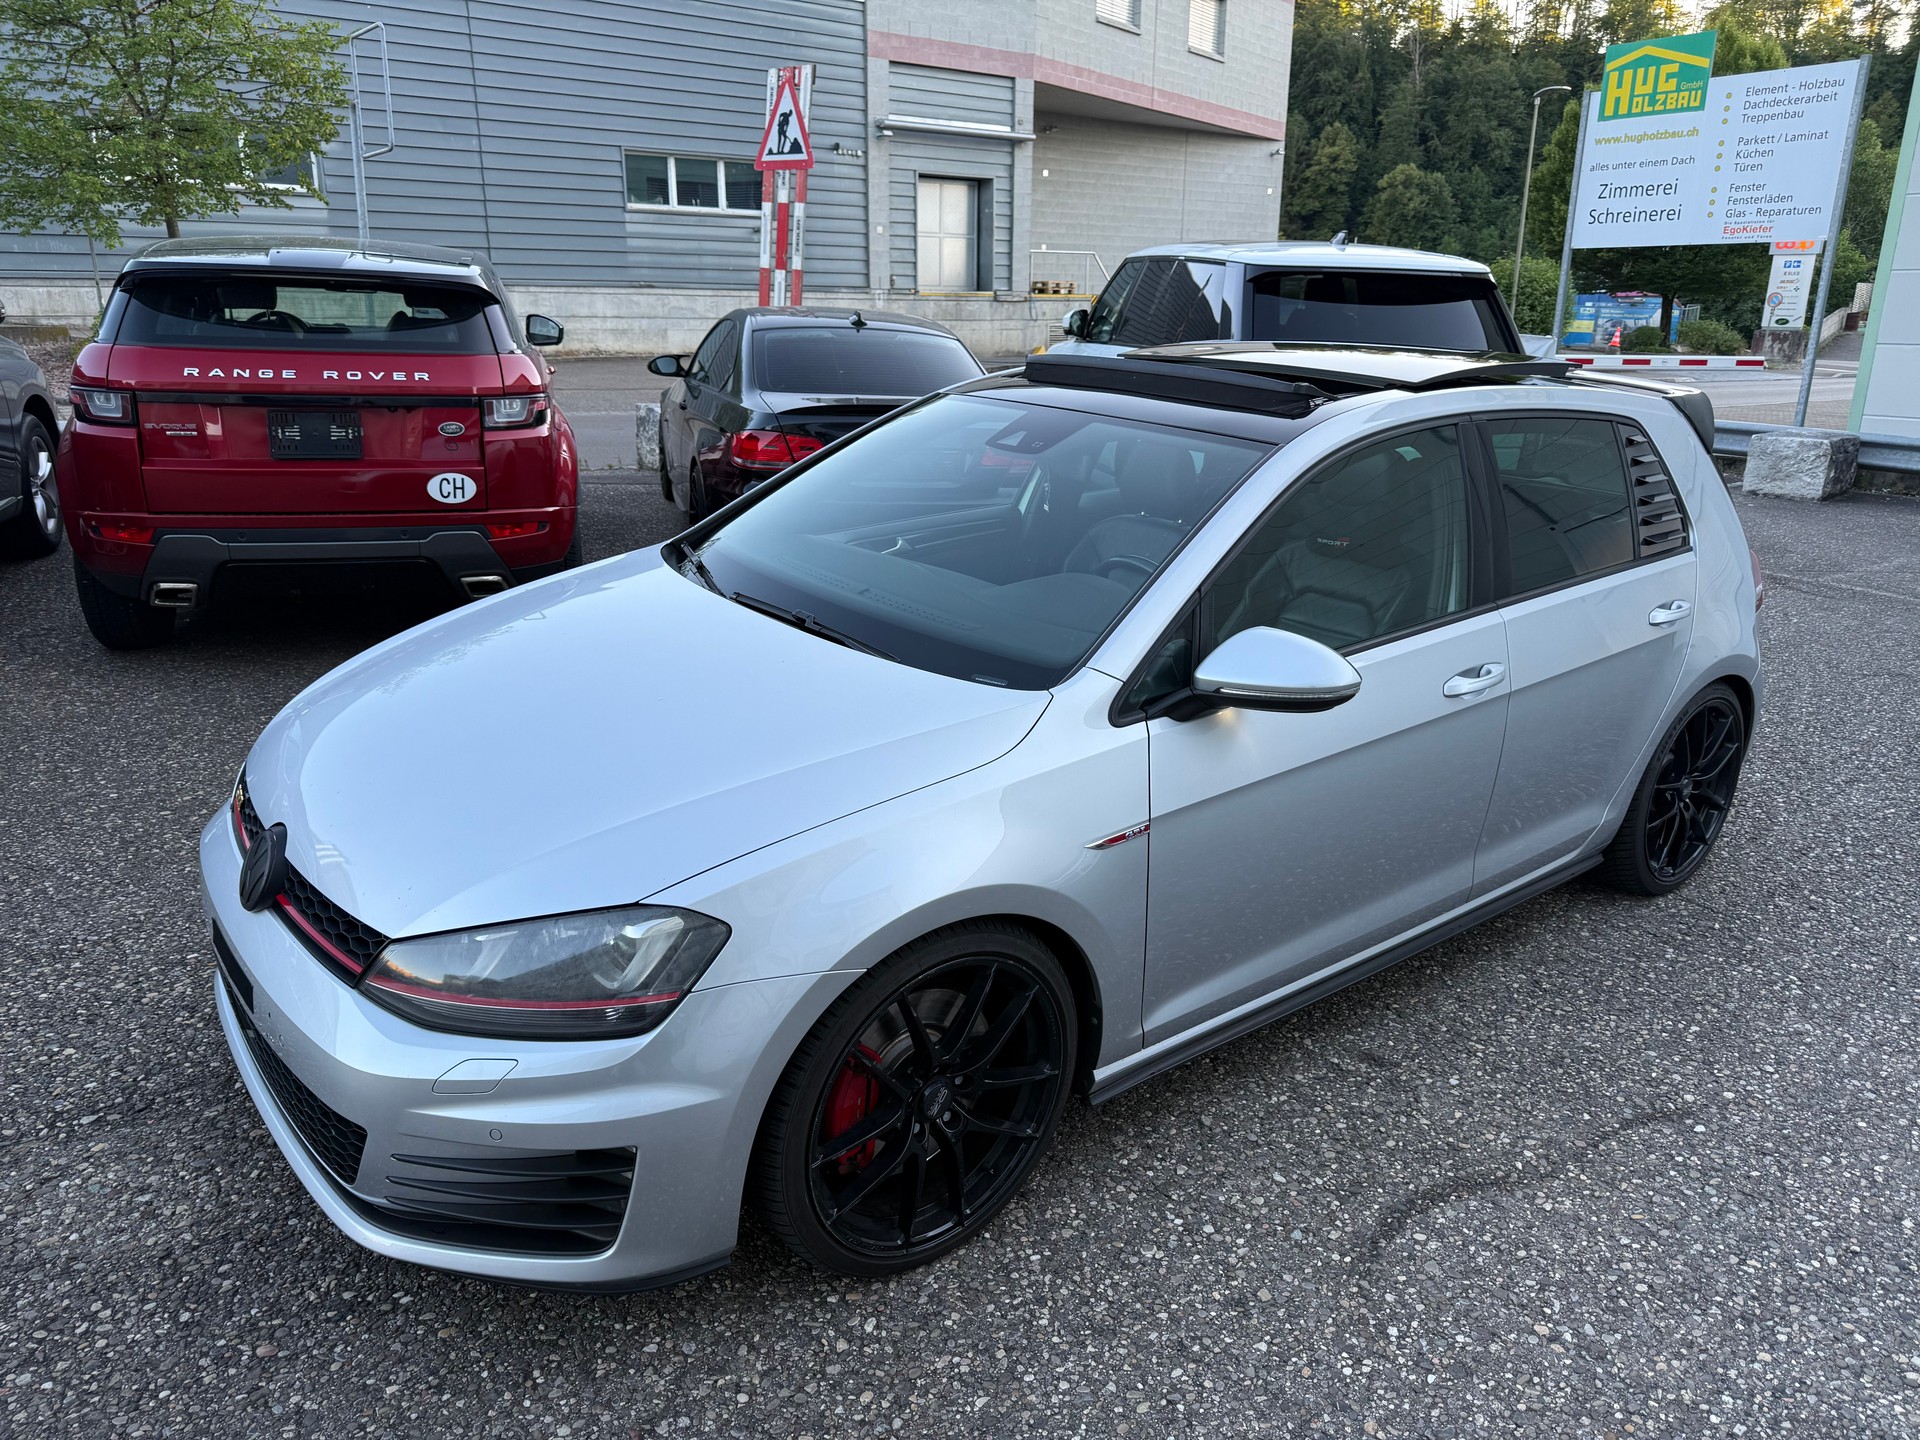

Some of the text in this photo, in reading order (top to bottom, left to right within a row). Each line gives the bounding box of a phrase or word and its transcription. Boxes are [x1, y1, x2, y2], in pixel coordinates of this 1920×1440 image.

[1604, 63, 1680, 116] HUG
[1680, 80, 1704, 90] GmbH
[1745, 83, 1789, 97] Element
[1798, 78, 1846, 91] Holzbau
[1743, 91, 1838, 110] Dachdeckerarbeit
[1741, 109, 1805, 125] Treppenbau
[1594, 126, 1699, 145] www.hugholzbau.ch
[1737, 134, 1775, 146] Parkett
[1784, 130, 1829, 143] Laminat
[1735, 148, 1774, 159] Küchen
[1589, 155, 1695, 172] alles unter einem Dach
[1733, 162, 1763, 172] Türen
[1597, 178, 1679, 199] Zimmerei
[1729, 183, 1767, 193] Fenster
[1727, 193, 1793, 206] Fensterläden
[1588, 204, 1682, 225] Schreinerei
[1725, 208, 1746, 219] Glas
[1755, 206, 1822, 219] Reparaturen
[1723, 224, 1774, 236] EgoKiefer
[183, 367, 431, 381] RANGE ROVER
[438, 477, 466, 499] CH
